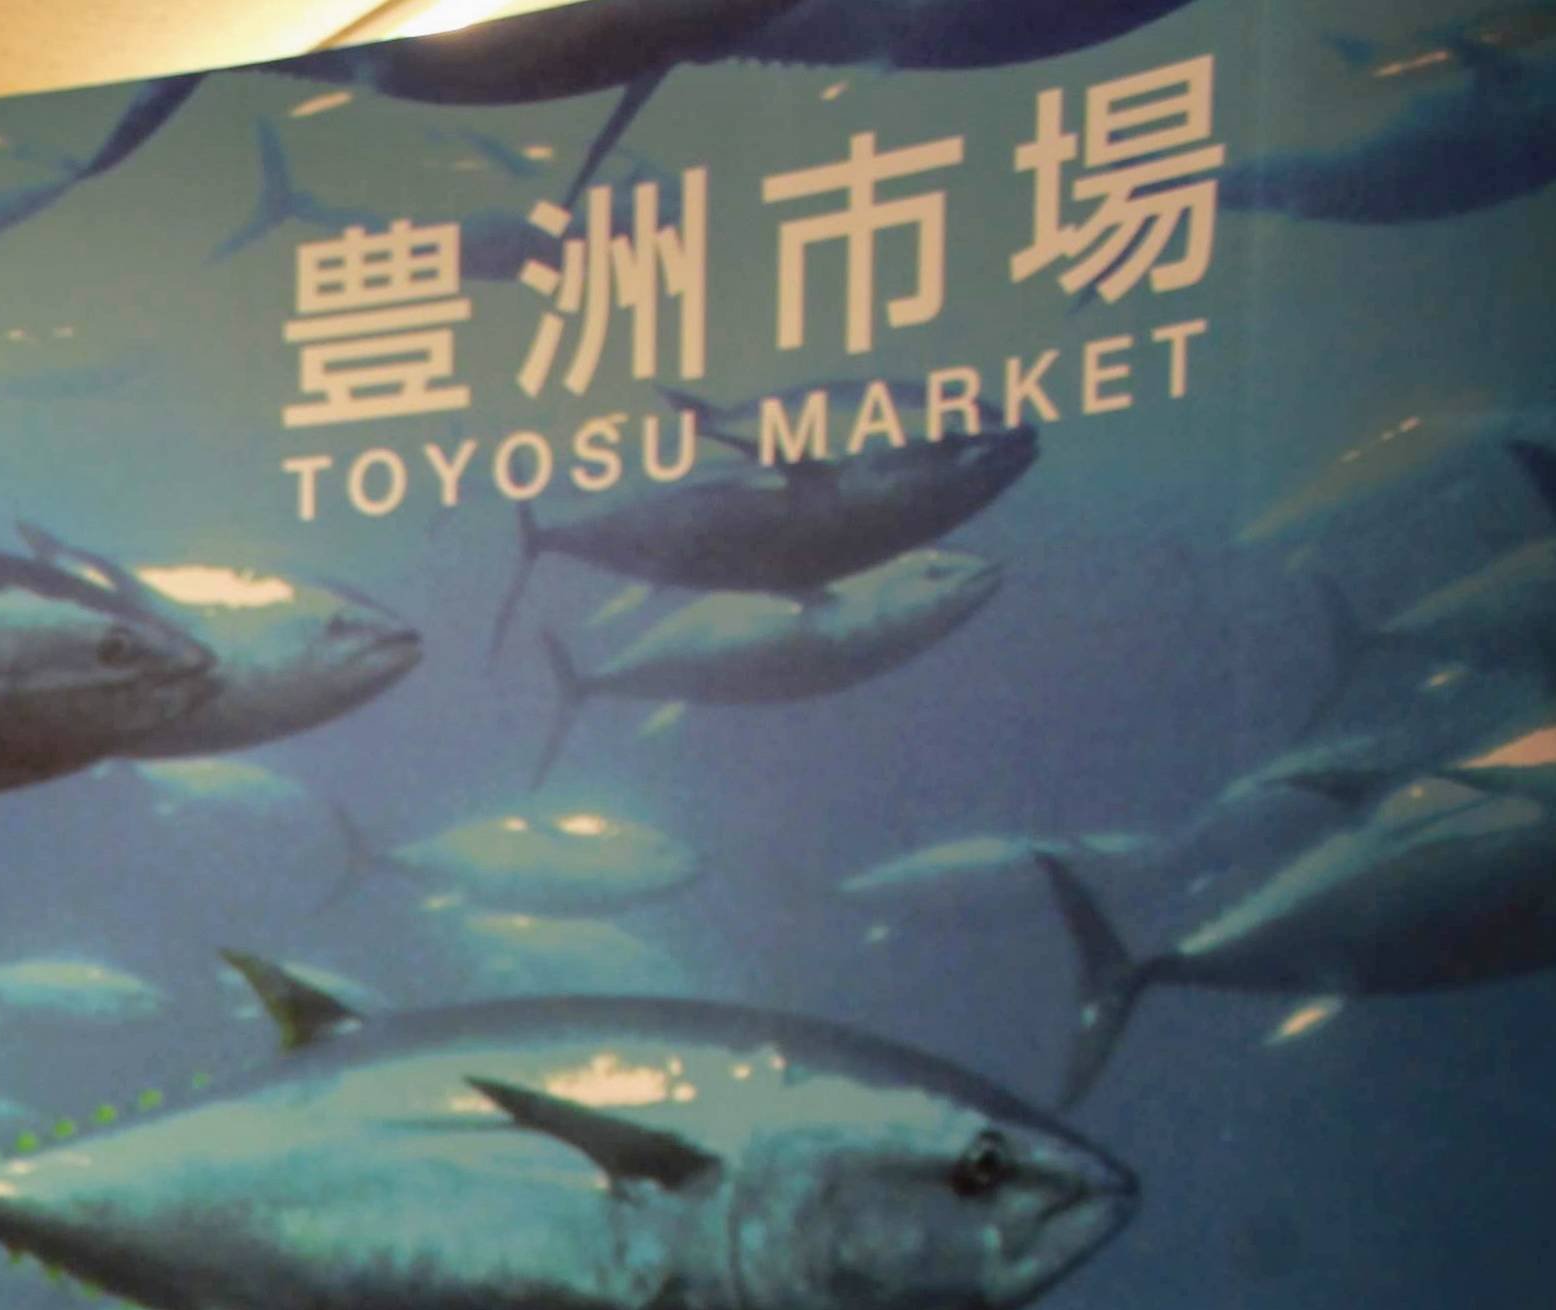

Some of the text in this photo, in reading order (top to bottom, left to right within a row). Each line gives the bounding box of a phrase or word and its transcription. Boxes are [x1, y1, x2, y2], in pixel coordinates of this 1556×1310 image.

[282, 53, 1226, 428] 豊洲市場
[282, 319, 1208, 522] TOYOSU MARKET
